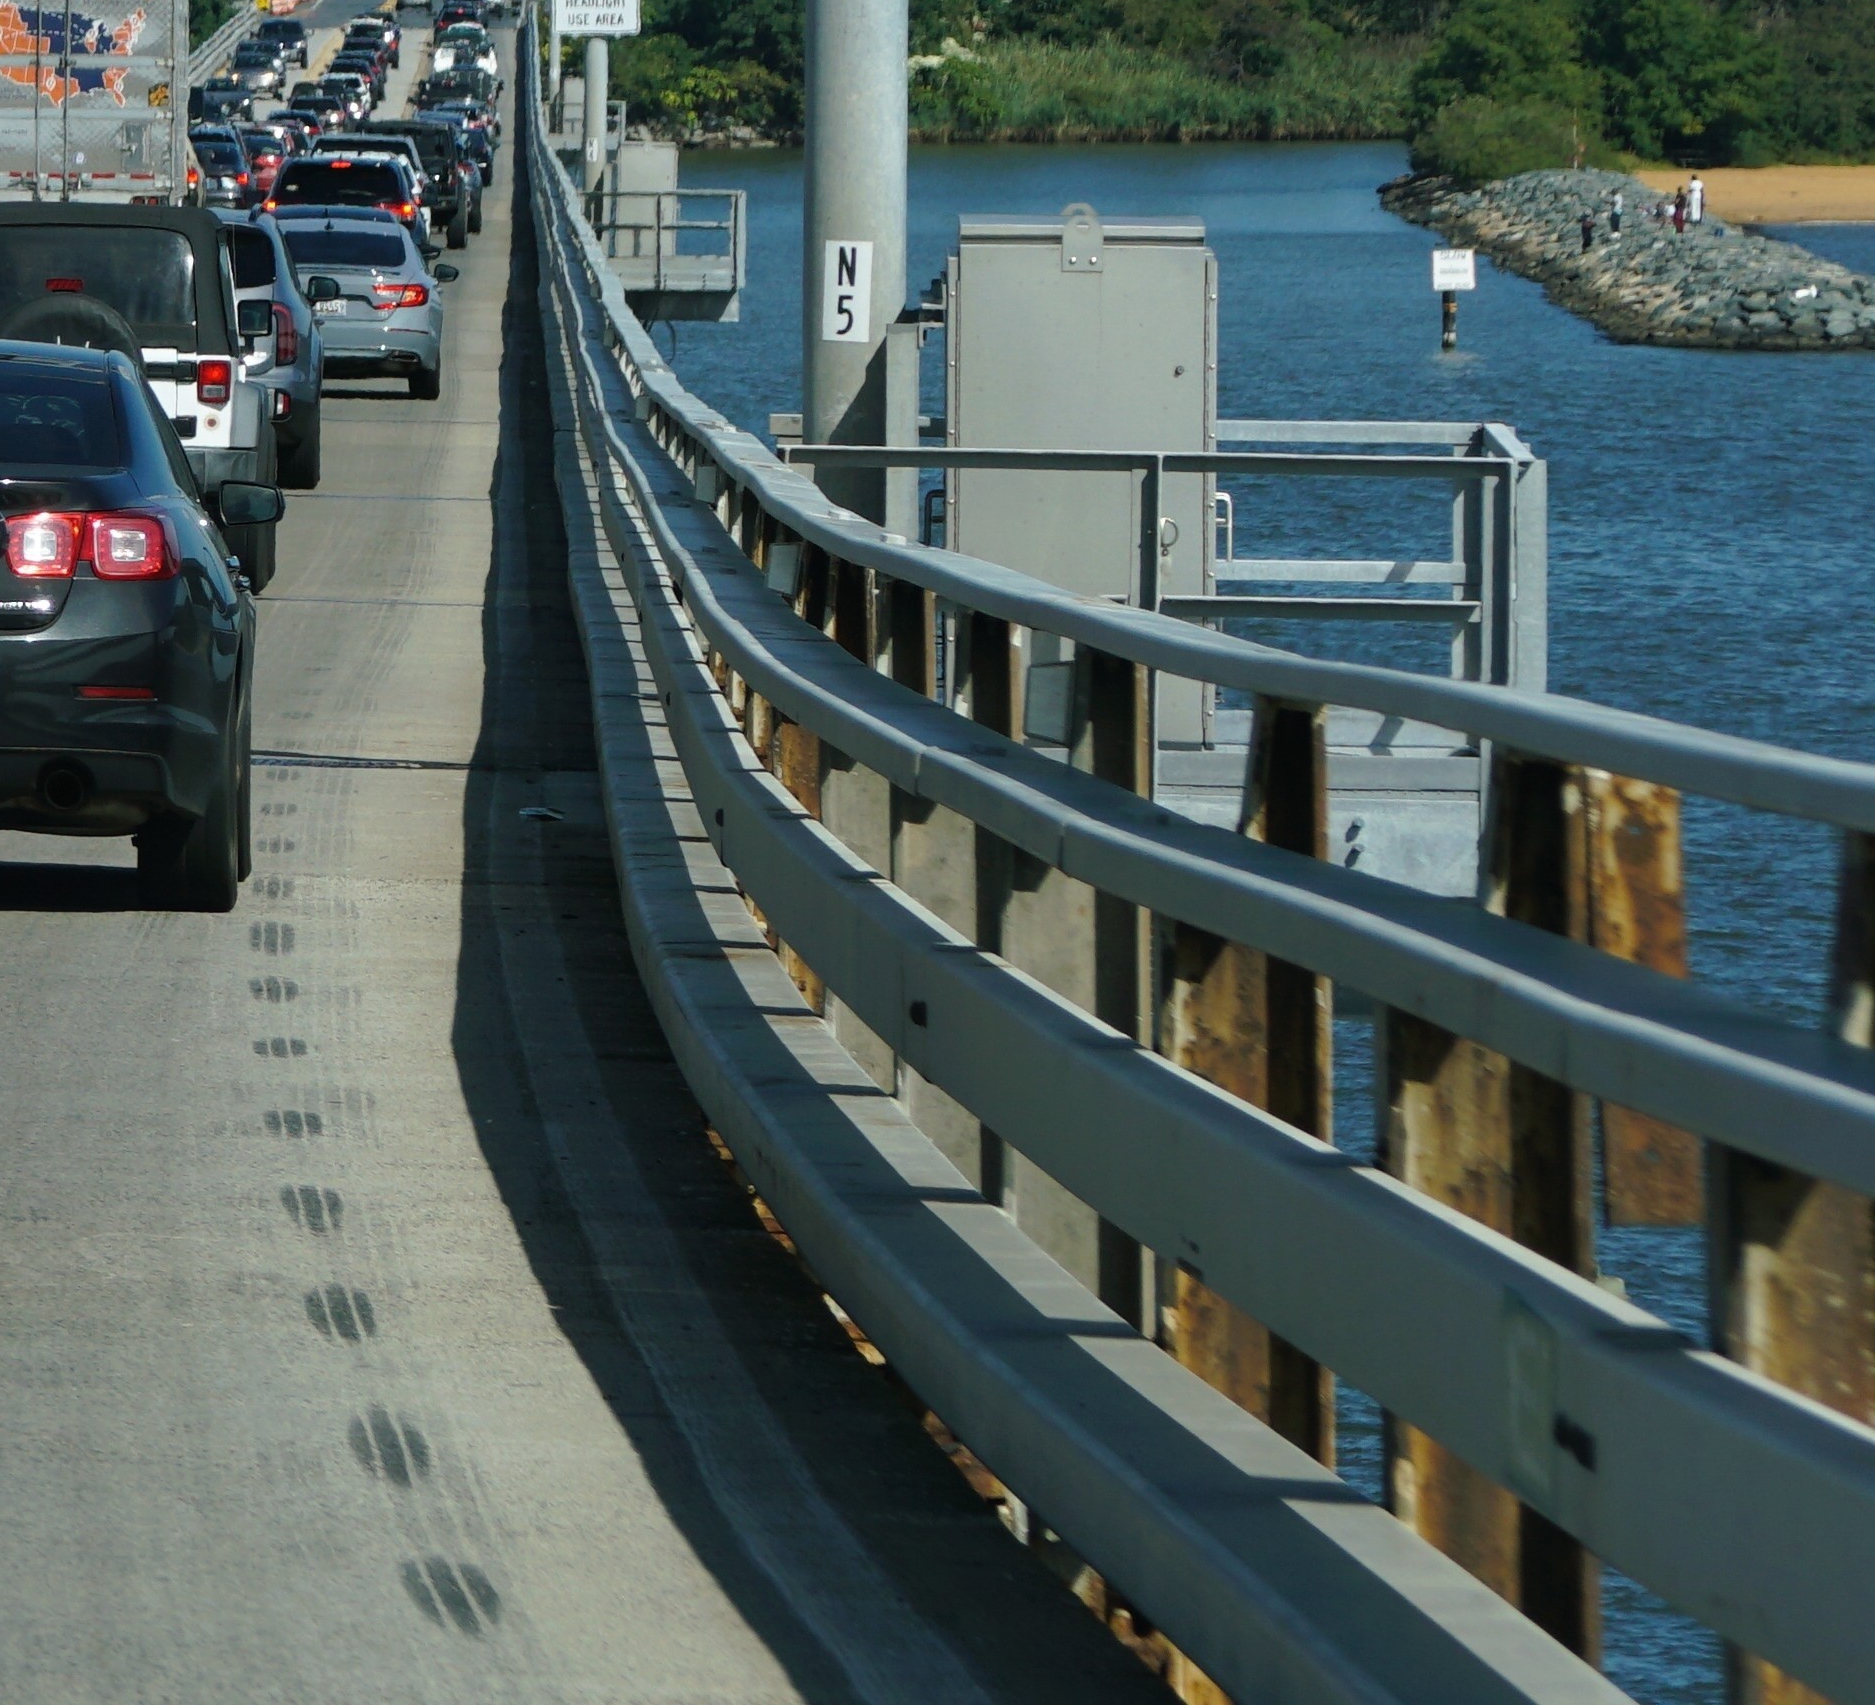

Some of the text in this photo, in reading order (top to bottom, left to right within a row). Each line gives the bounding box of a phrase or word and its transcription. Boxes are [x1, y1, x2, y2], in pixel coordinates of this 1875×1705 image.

[567, 12, 624, 26] USE AREA
[837, 245, 858, 288] N
[835, 294, 855, 335] 5
